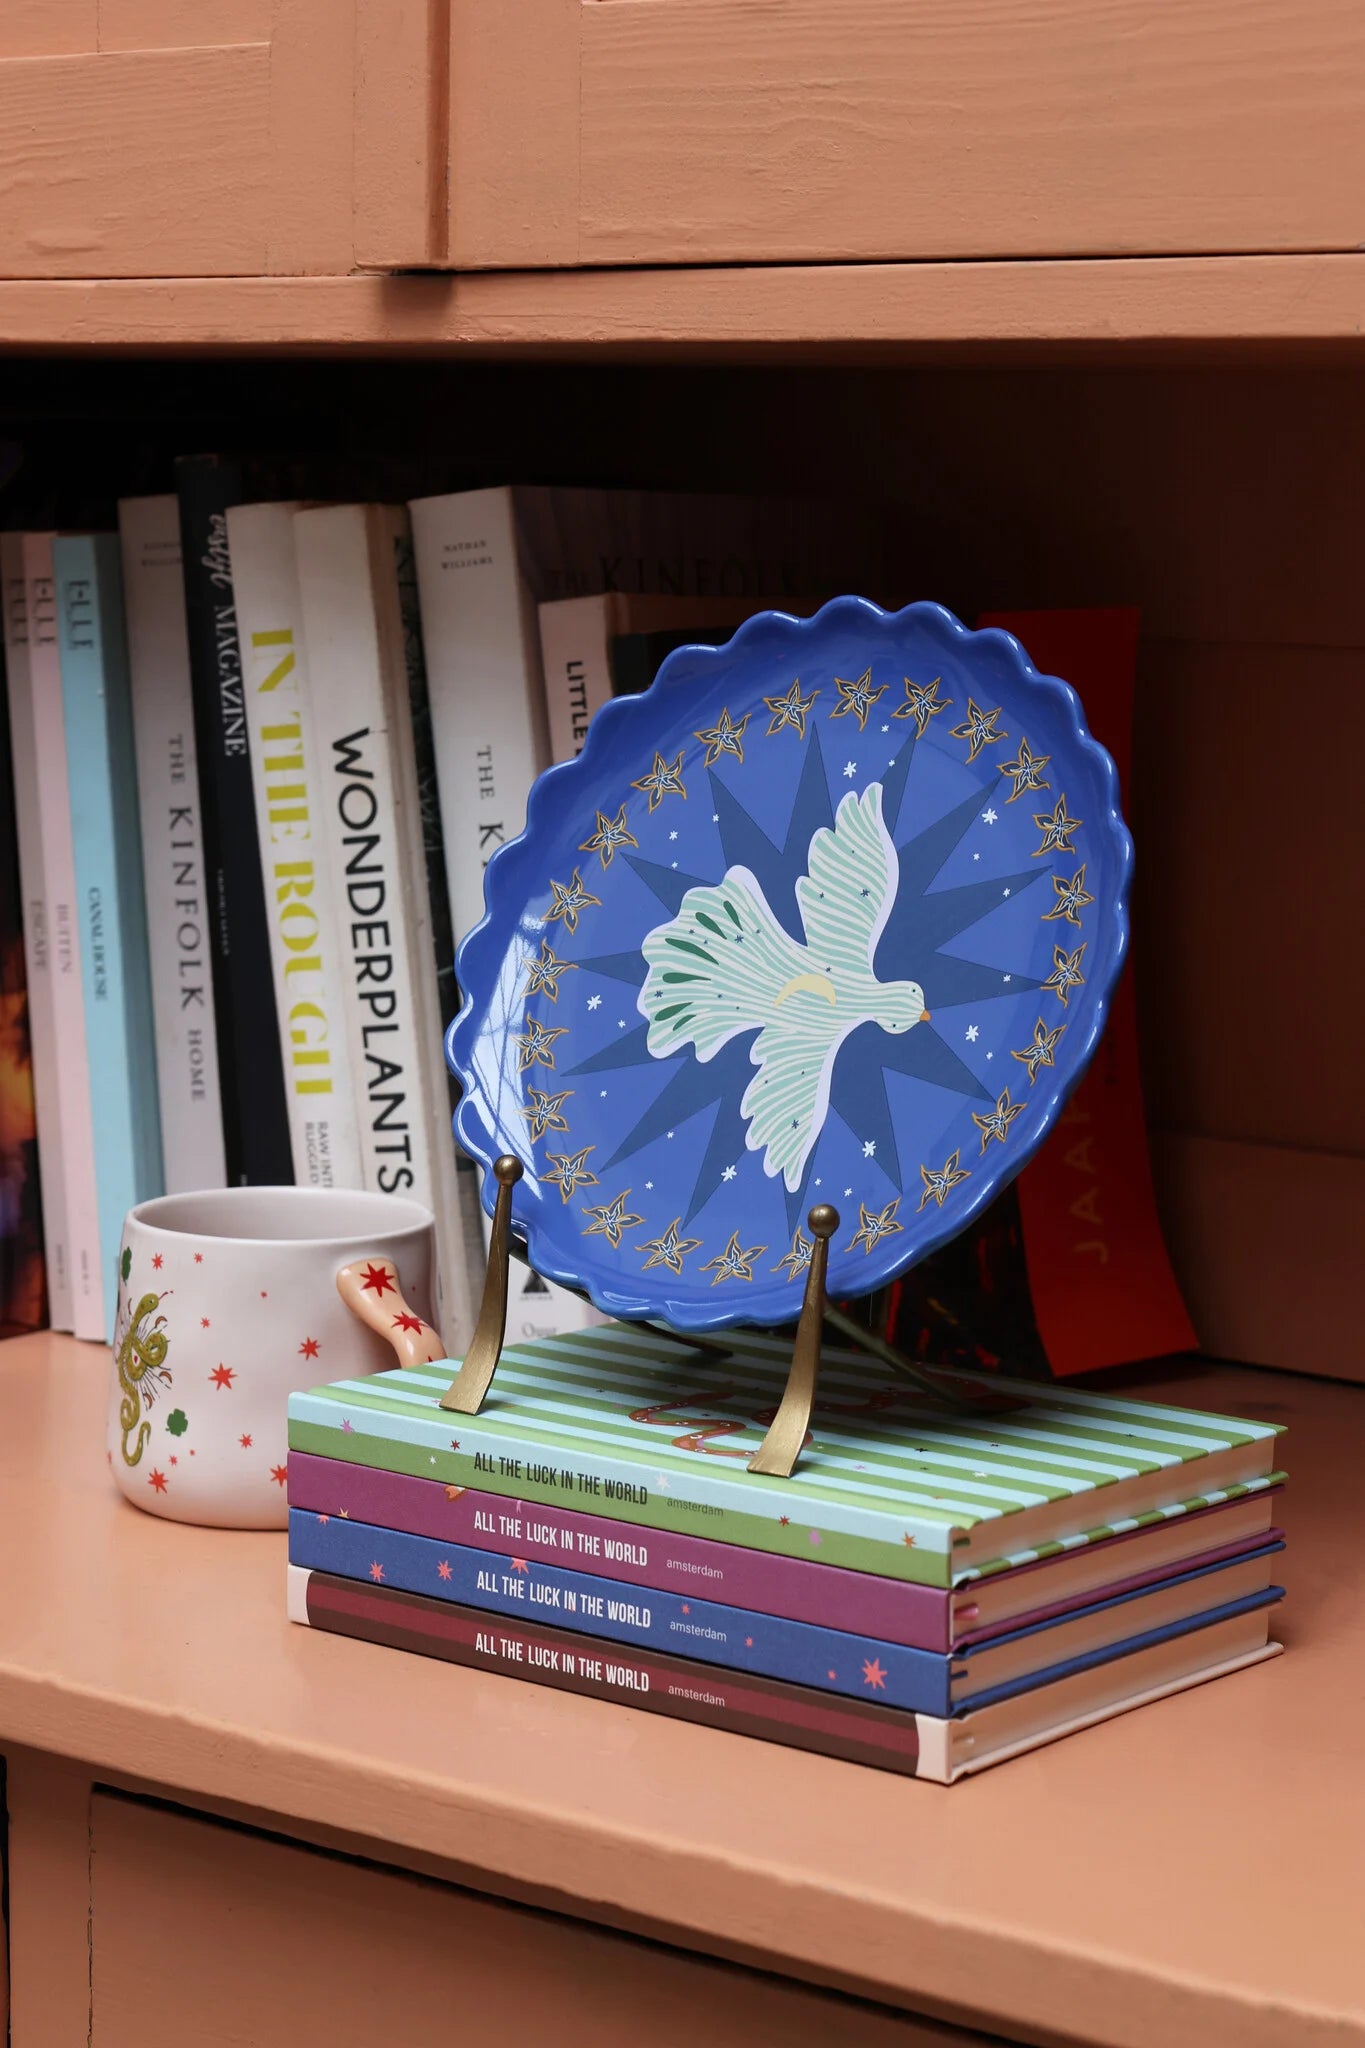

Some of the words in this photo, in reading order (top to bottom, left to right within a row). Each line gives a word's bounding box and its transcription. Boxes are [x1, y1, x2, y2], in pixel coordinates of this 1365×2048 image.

[440, 556, 494, 570] WILLIAMS
[443, 540, 487, 554] NATHAN
[32, 577, 55, 646] ELLE
[66, 580, 94, 650] ELLE
[213, 605, 247, 757] MAGAZINE
[251, 629, 298, 693] IN
[566, 661, 588, 740] LITTLE
[168, 734, 185, 782] THE
[261, 711, 311, 843] THE
[477, 745, 495, 799] THE
[478, 821, 505, 868] K
[169, 806, 205, 1011] KINFOLK
[274, 860, 334, 1095] ROUGH
[332, 726, 414, 1193] WONDERPLANTS
[188, 1029, 206, 1101] HOME
[474, 1452, 495, 1473] ALL
[499, 1456, 521, 1479] THE
[526, 1462, 557, 1487] LUCK
[561, 1470, 573, 1490] IN
[577, 1473, 600, 1496] THE
[604, 1478, 648, 1505] WORLD
[667, 1497, 724, 1517] amsterdam
[474, 1511, 495, 1534] ALL
[499, 1516, 521, 1540] THE
[526, 1522, 557, 1547] LUCK
[561, 1529, 573, 1551] IN
[577, 1533, 600, 1556] THE
[604, 1539, 648, 1567] WORLD
[666, 1558, 724, 1580] amsterdam
[477, 1570, 498, 1593] ALL
[502, 1576, 524, 1600] THE
[529, 1582, 560, 1608] LUCK
[564, 1589, 577, 1610] IN
[580, 1594, 604, 1618] THE
[607, 1599, 651, 1628] WORLD
[670, 1620, 727, 1642] amsterdam
[475, 1632, 497, 1655] ALL
[500, 1638, 523, 1662] THE
[528, 1645, 559, 1671] LUCK
[562, 1653, 575, 1674] IN
[579, 1657, 602, 1681] THE
[606, 1663, 650, 1692] WORLD
[668, 1684, 725, 1707] amsterdam
